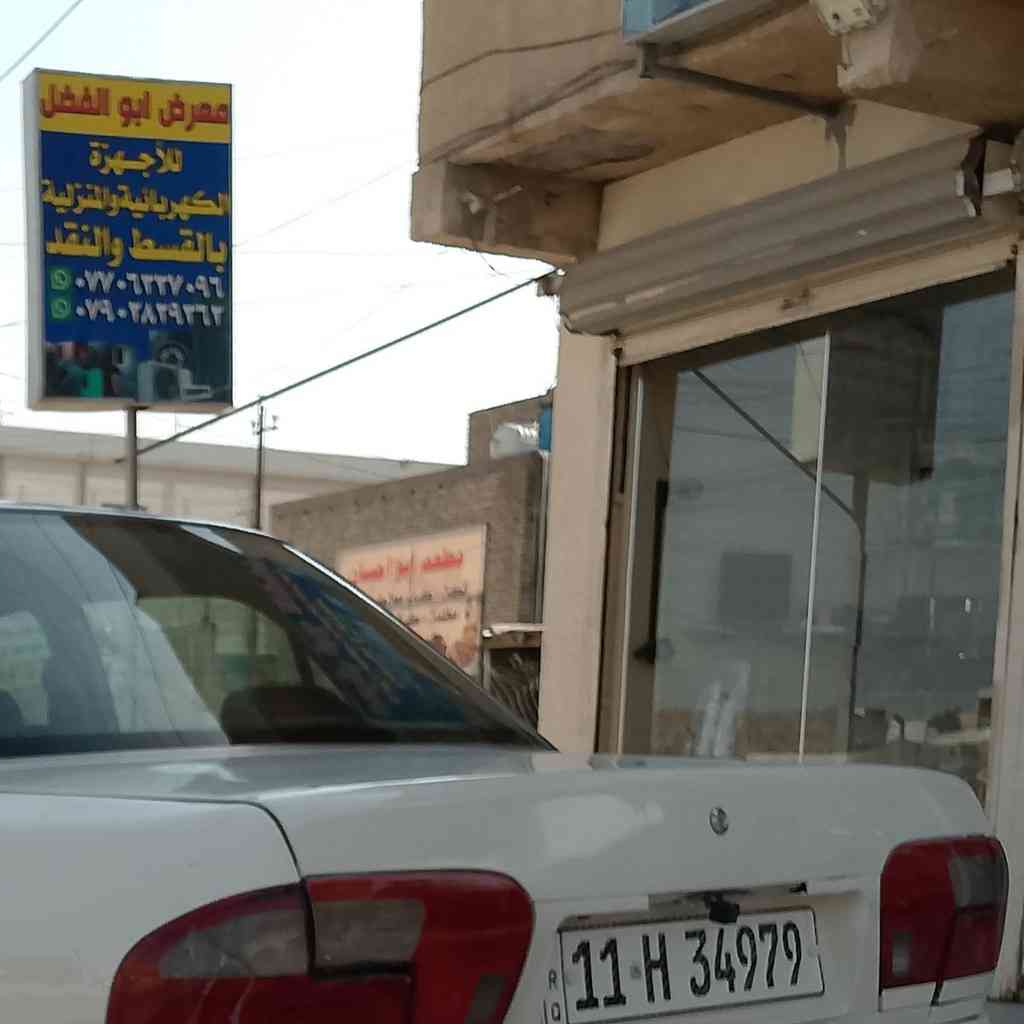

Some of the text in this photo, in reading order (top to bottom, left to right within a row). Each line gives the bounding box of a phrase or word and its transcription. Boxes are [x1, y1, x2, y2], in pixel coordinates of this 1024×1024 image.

[158, 92, 229, 131] معرض
[45, 221, 228, 272] بالقسط والنقد
[571, 920, 803, 1011] 11 H 34979
